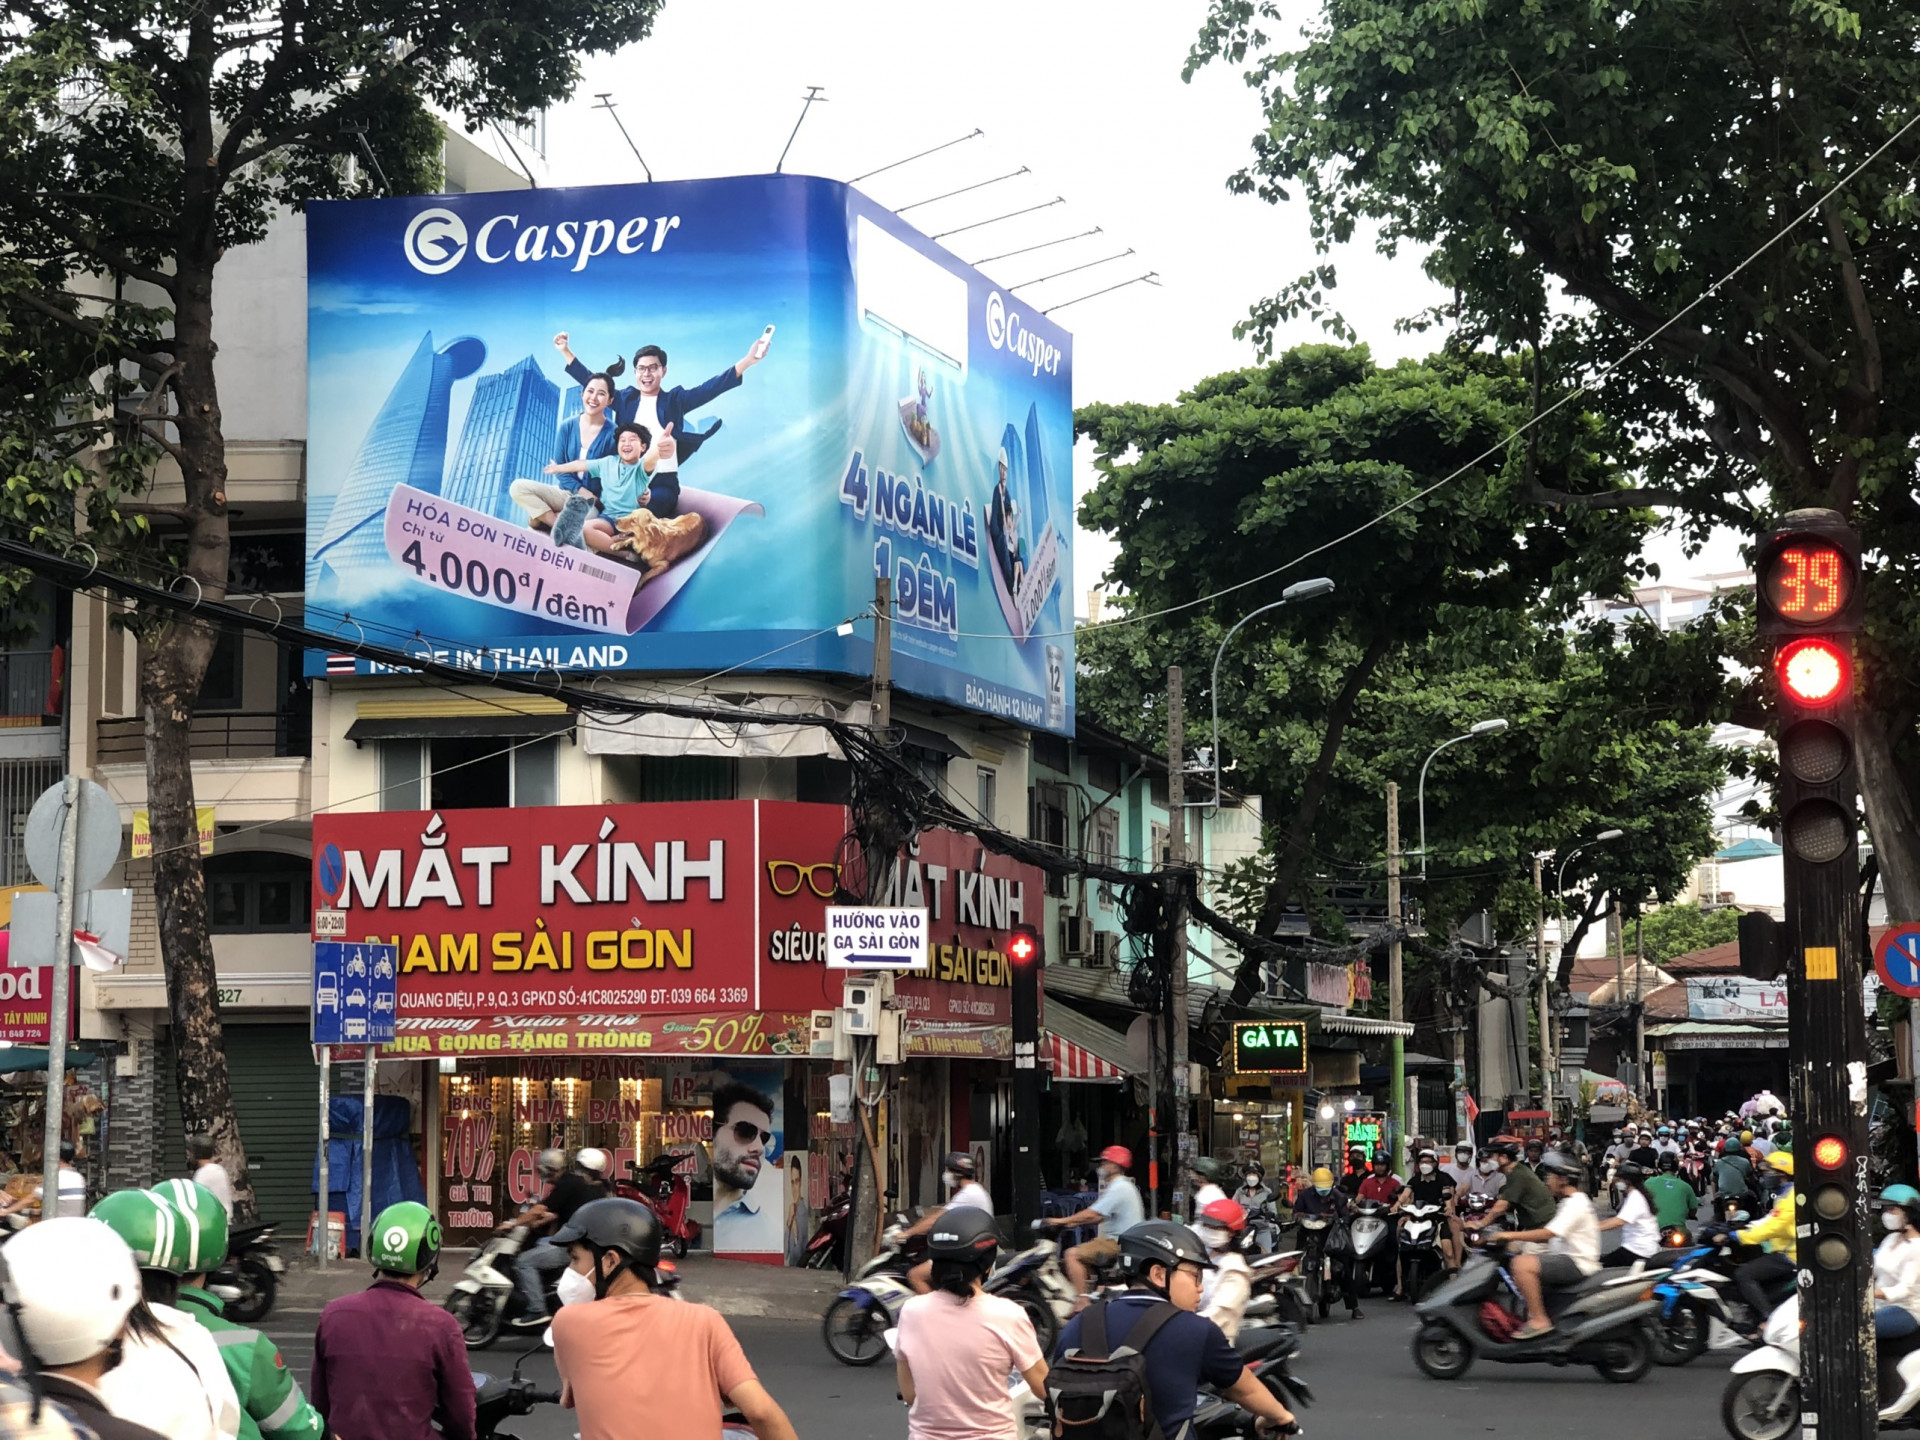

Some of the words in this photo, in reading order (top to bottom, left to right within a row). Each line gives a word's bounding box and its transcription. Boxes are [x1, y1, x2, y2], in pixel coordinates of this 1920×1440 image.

[475, 214, 681, 273] Casper
[1006, 312, 1061, 377] Casper
[840, 446, 870, 517] 4
[875, 470, 947, 546] NGÀN
[950, 497, 979, 566] LẺ
[402, 521, 426, 538] Chỉ
[406, 499, 450, 527] HÓA
[457, 517, 497, 543] ĐƠN
[503, 533, 538, 558] TIỀN
[540, 551, 574, 571] ĐIỆN
[897, 552, 958, 636] ĐÊM
[1781, 551, 1839, 613] 39
[456, 649, 481, 670] IN
[490, 645, 628, 670] THAILAND
[1049, 664, 1061, 692] 12
[965, 678, 984, 708] BẢO
[986, 687, 1010, 717] HÀNH
[1012, 699, 1021, 720] 12
[337, 812, 509, 908] MẮT
[540, 816, 724, 904] KÍNH
[959, 849, 1024, 930] KÍNH
[832, 911, 885, 929] HƯỚNG
[891, 911, 921, 928] VÀO
[492, 916, 572, 973] SÀI
[585, 916, 692, 970] GÒN
[771, 922, 815, 962] SIÊU
[833, 935, 854, 949] GA
[858, 932, 884, 949] SÀI
[889, 932, 920, 949] GÒN
[940, 933, 971, 983] SÀI
[976, 937, 1012, 987] GÒN
[400, 992, 443, 1008] QUANG
[445, 990, 475, 1010] DIỆU,
[521, 990, 556, 1007] GPKD
[694, 988, 716, 1003] 664
[720, 987, 748, 1002] 3369
[4, 1010, 21, 1025] TÂY
[24, 1012, 47, 1025] NINH
[396, 1016, 480, 1031] Mừng
[488, 1015, 569, 1029] Xuân
[576, 1013, 642, 1027] Mới
[684, 1012, 765, 1053] 50%
[27, 1029, 41, 1038] 724
[383, 1035, 432, 1053] MUA
[438, 1033, 501, 1054] GỌNG
[508, 1029, 568, 1052] TẶNG
[574, 1028, 652, 1048] TRÒNG
[906, 1036, 924, 1054] ỌNG
[1242, 1025, 1271, 1048] GÀ
[1272, 1029, 1299, 1047] TA
[670, 1073, 696, 1101] ÁP
[589, 1091, 641, 1123] BÁN
[654, 1108, 713, 1139] TRÒNG
[444, 1115, 496, 1182] 70%
[450, 1182, 468, 1203] GIÁ
[472, 1185, 491, 1205] THỊ
[448, 1208, 493, 1228] TRƯỜNG
